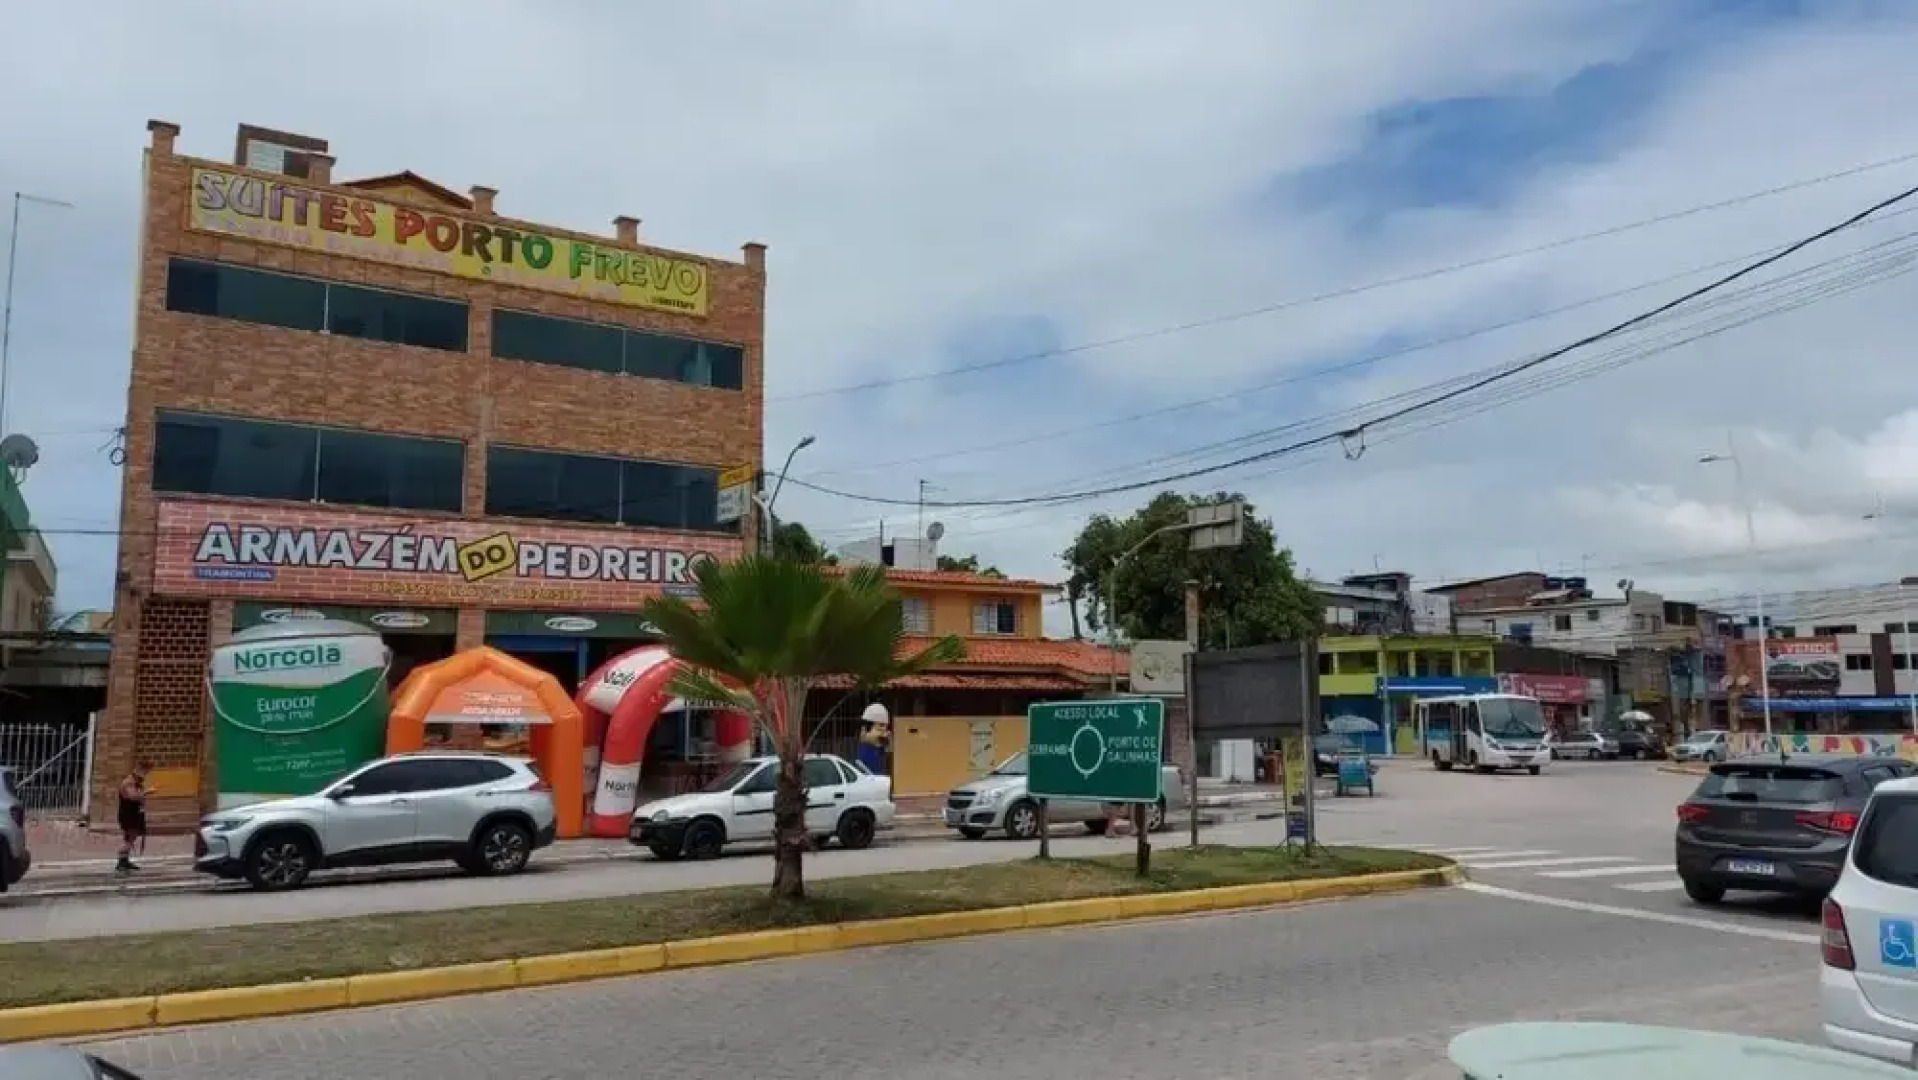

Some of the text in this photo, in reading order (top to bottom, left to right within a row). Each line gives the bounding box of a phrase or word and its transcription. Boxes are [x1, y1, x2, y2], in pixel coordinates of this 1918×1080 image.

[394, 207, 554, 270] PORTO
[569, 242, 702, 296] FREVO
[194, 521, 461, 575] ARMAZÉM
[467, 544, 505, 571] DO
[233, 644, 341, 670] Norcola
[256, 694, 318, 713] Eurocor
[1053, 704, 1120, 720] ACESSO LOCAL
[1142, 735, 1157, 749] DE
